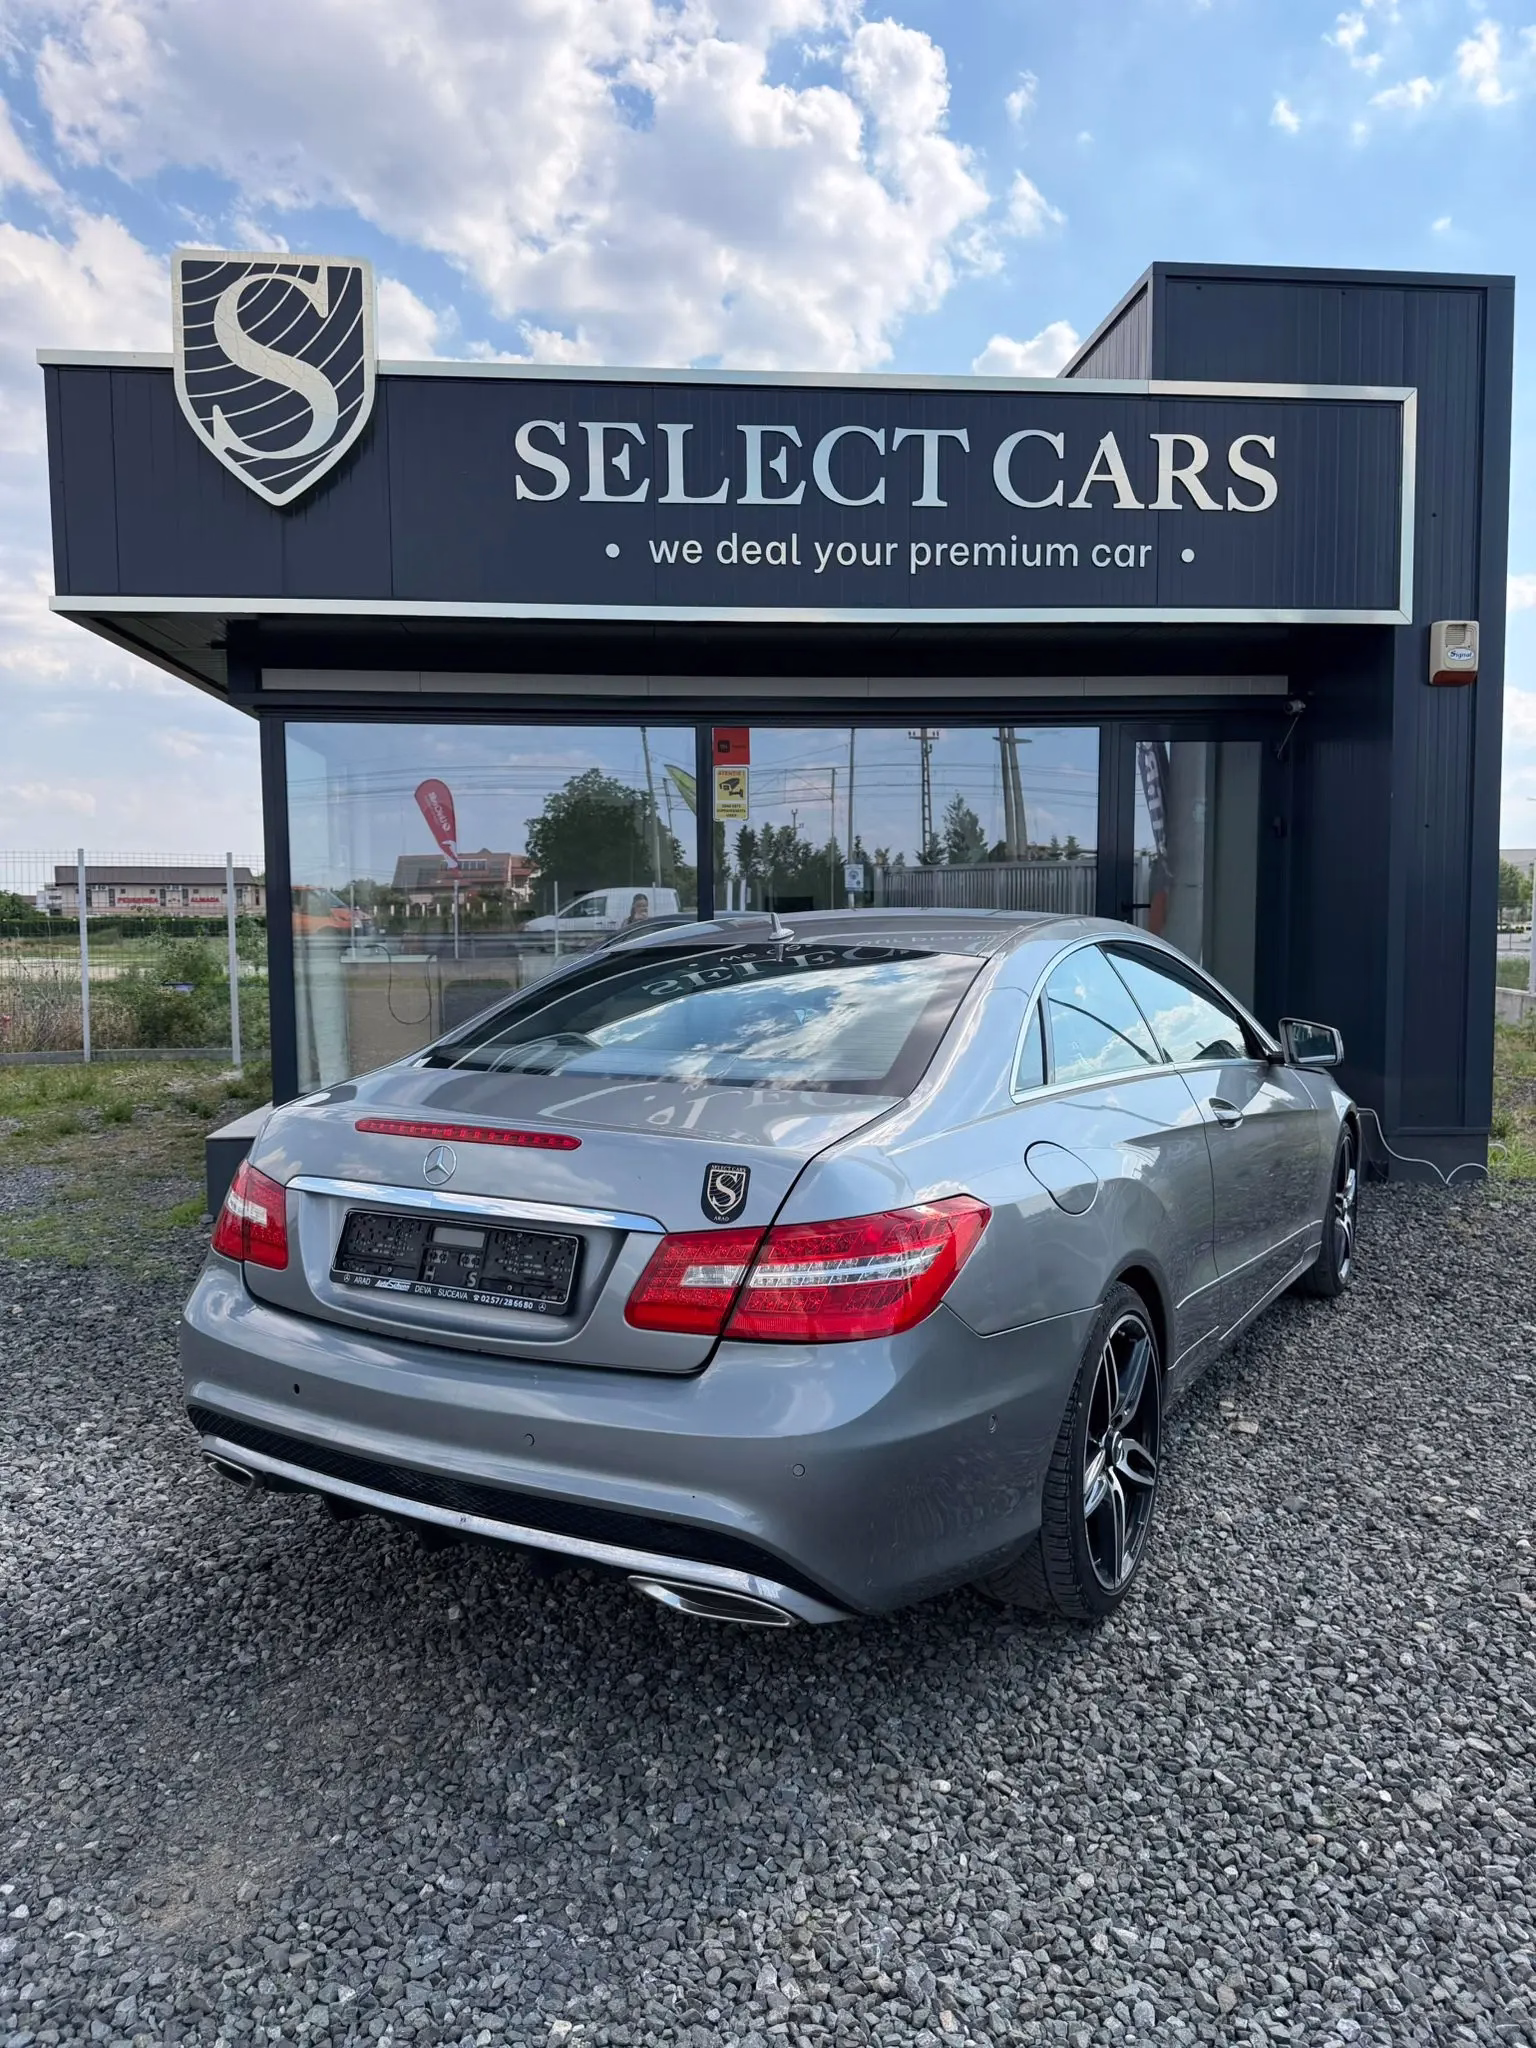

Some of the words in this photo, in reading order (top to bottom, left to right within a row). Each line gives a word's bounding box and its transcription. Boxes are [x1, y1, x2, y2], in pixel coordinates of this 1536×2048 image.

[213, 265, 339, 459] S
[514, 419, 970, 508] SELECT
[993, 430, 1278, 512] CARS
[649, 540, 703, 565] we
[717, 532, 803, 566] deal
[815, 542, 899, 575] your
[911, 534, 1079, 575] premium
[1092, 543, 1152, 568] car
[1449, 650, 1473, 659] Signal
[353, 1276, 371, 1286] ARAD
[414, 1285, 432, 1295] DEVA
[437, 1288, 468, 1300] SUCEAVA
[467, 1272, 477, 1287] S
